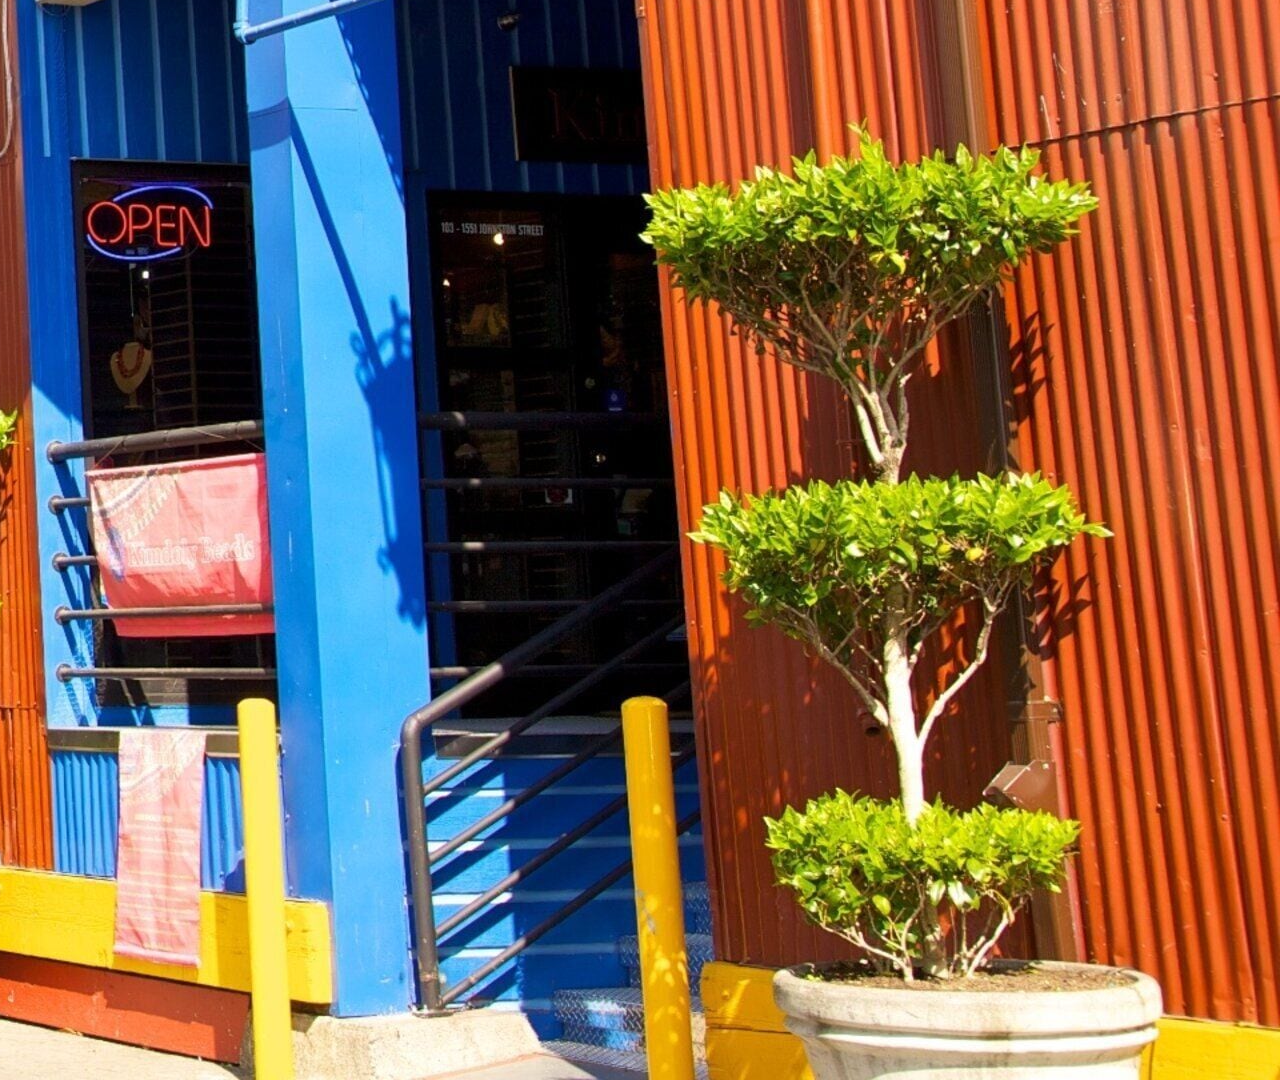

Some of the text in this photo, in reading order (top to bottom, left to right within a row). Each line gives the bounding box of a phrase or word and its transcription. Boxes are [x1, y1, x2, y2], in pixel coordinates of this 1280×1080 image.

[87, 201, 211, 247] OPEN
[518, 224, 544, 236] STREET
[199, 532, 257, 564] Beads
